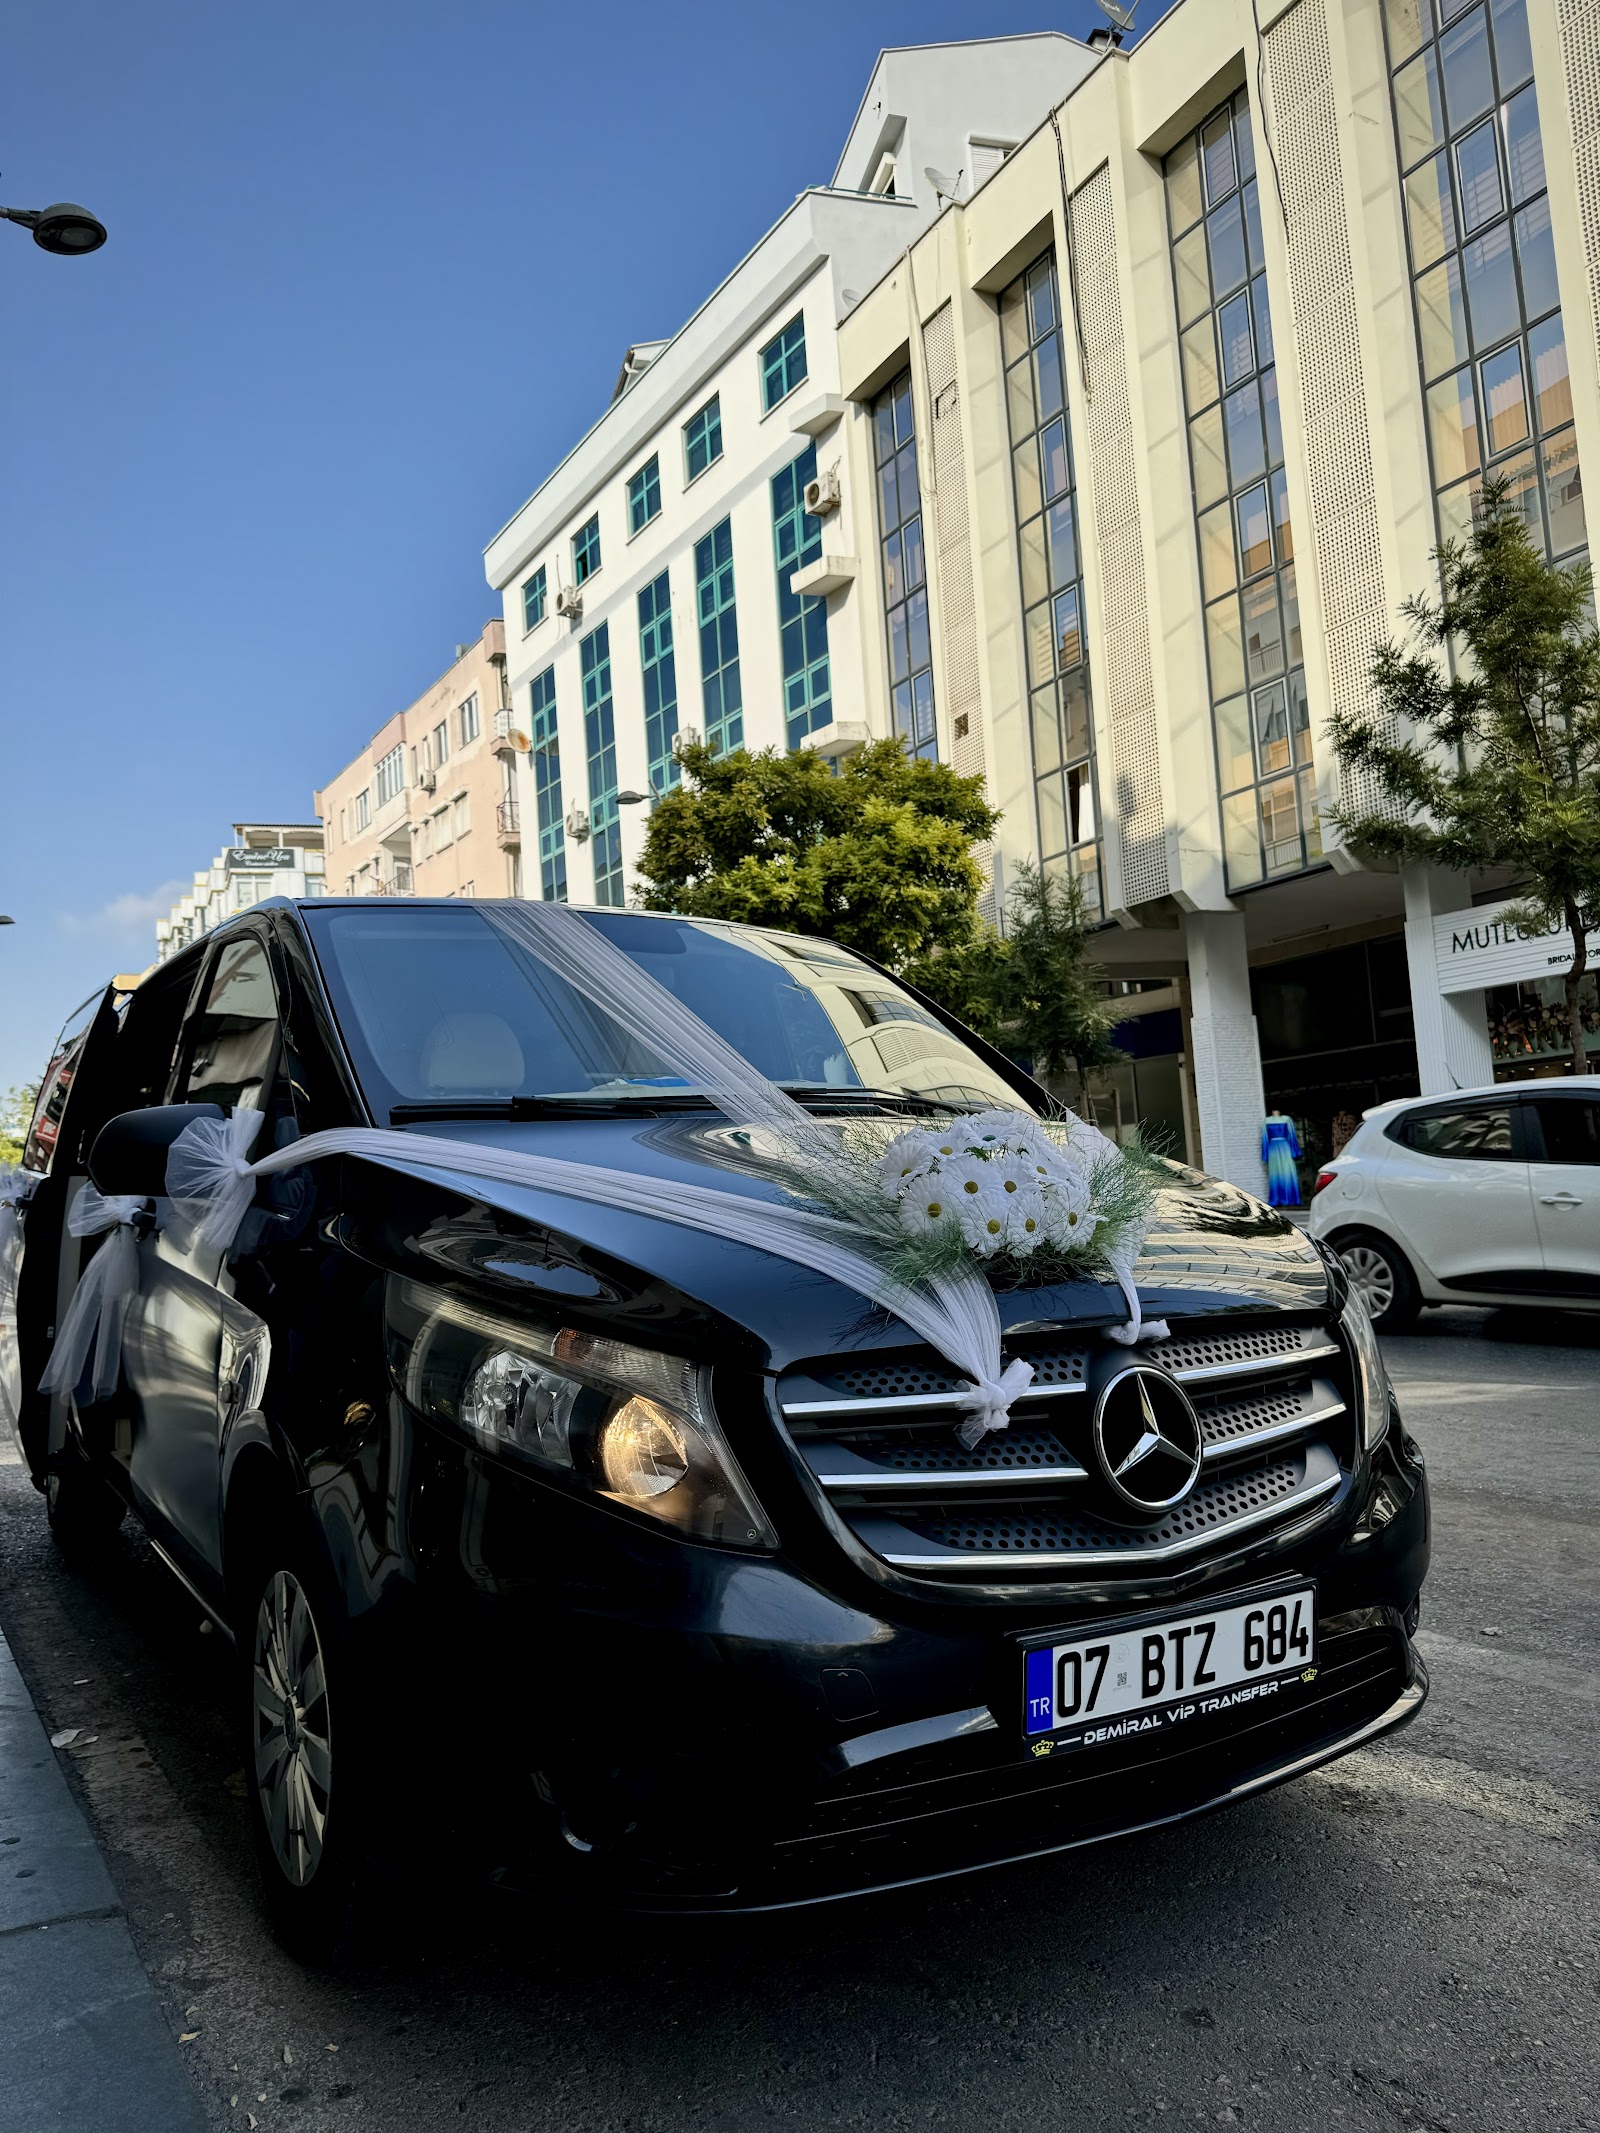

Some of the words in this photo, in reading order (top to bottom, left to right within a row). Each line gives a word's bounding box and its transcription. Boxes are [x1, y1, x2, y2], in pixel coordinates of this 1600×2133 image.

[1056, 1644, 1110, 1718] 07
[1141, 1620, 1216, 1699] BTZ
[1243, 1599, 1310, 1672] 684
[1029, 1696, 1050, 1718] TR
[1083, 1713, 1163, 1746] DEMİRAL
[1198, 1680, 1279, 1714] TRANSFER
